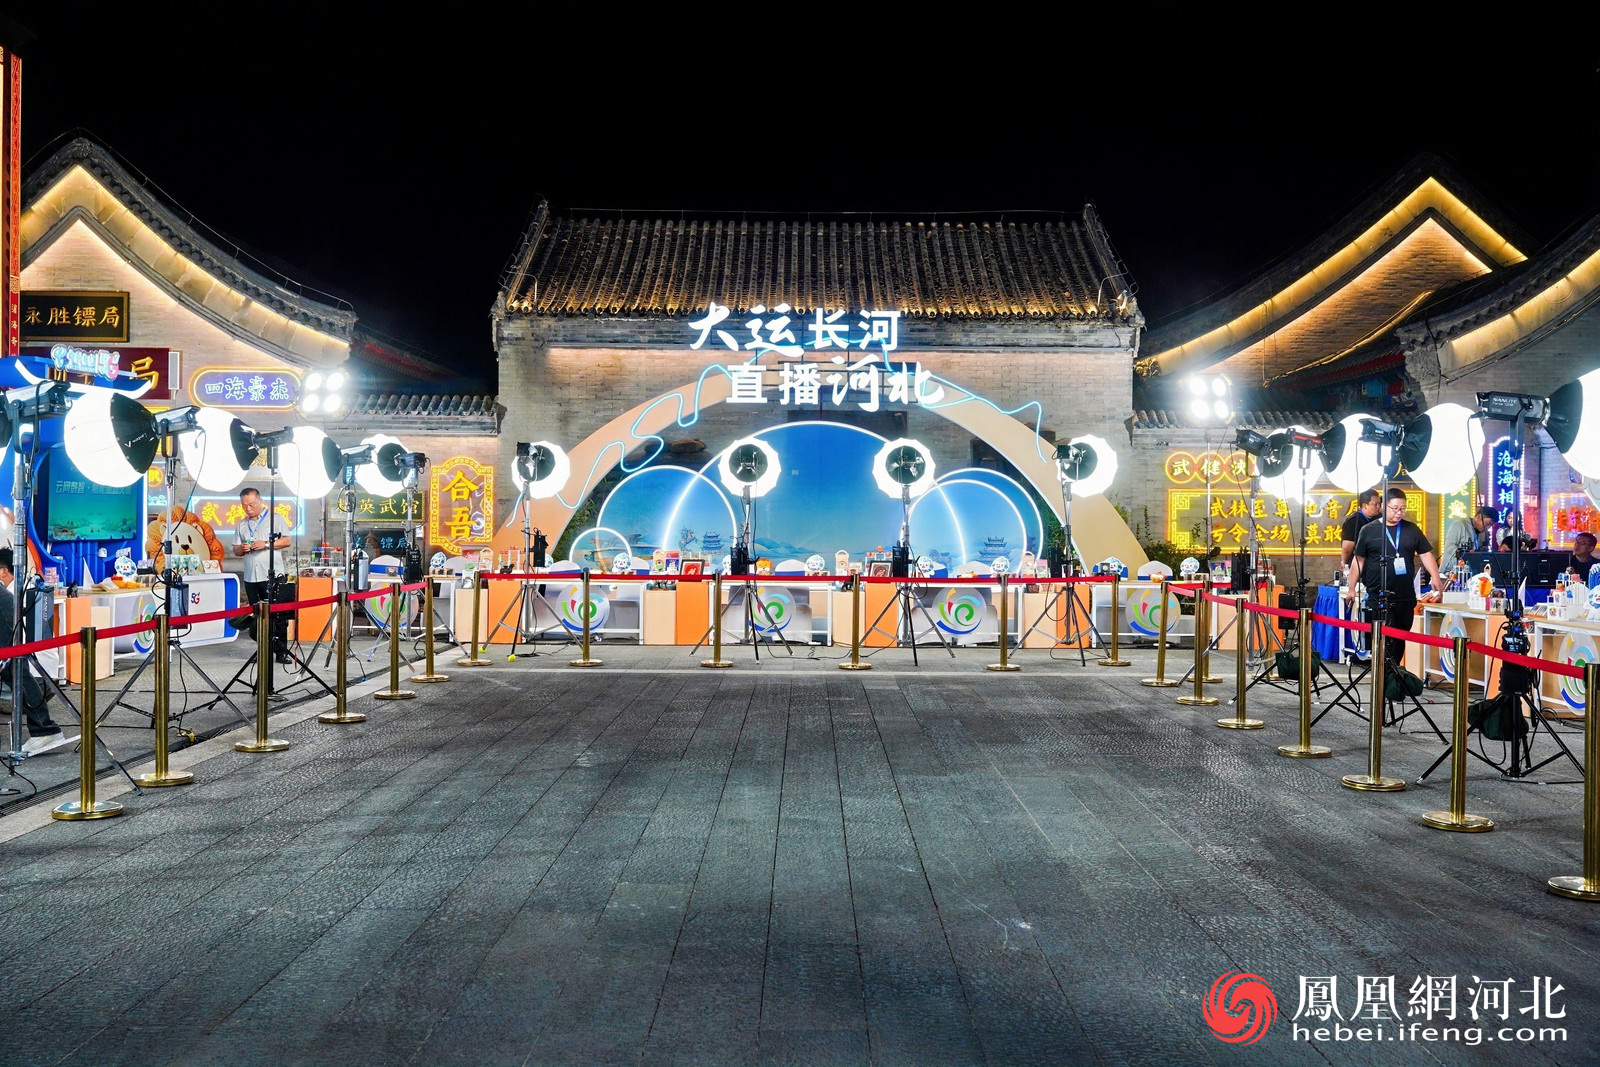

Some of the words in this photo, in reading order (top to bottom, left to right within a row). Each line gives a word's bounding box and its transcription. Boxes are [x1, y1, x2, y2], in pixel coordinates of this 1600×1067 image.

[22, 305, 121, 328] 永胜镖局
[688, 302, 901, 357] 大运长河
[205, 376, 290, 401] 四海豪杰
[726, 354, 945, 412] 直播河北
[441, 469, 480, 539] 合吾
